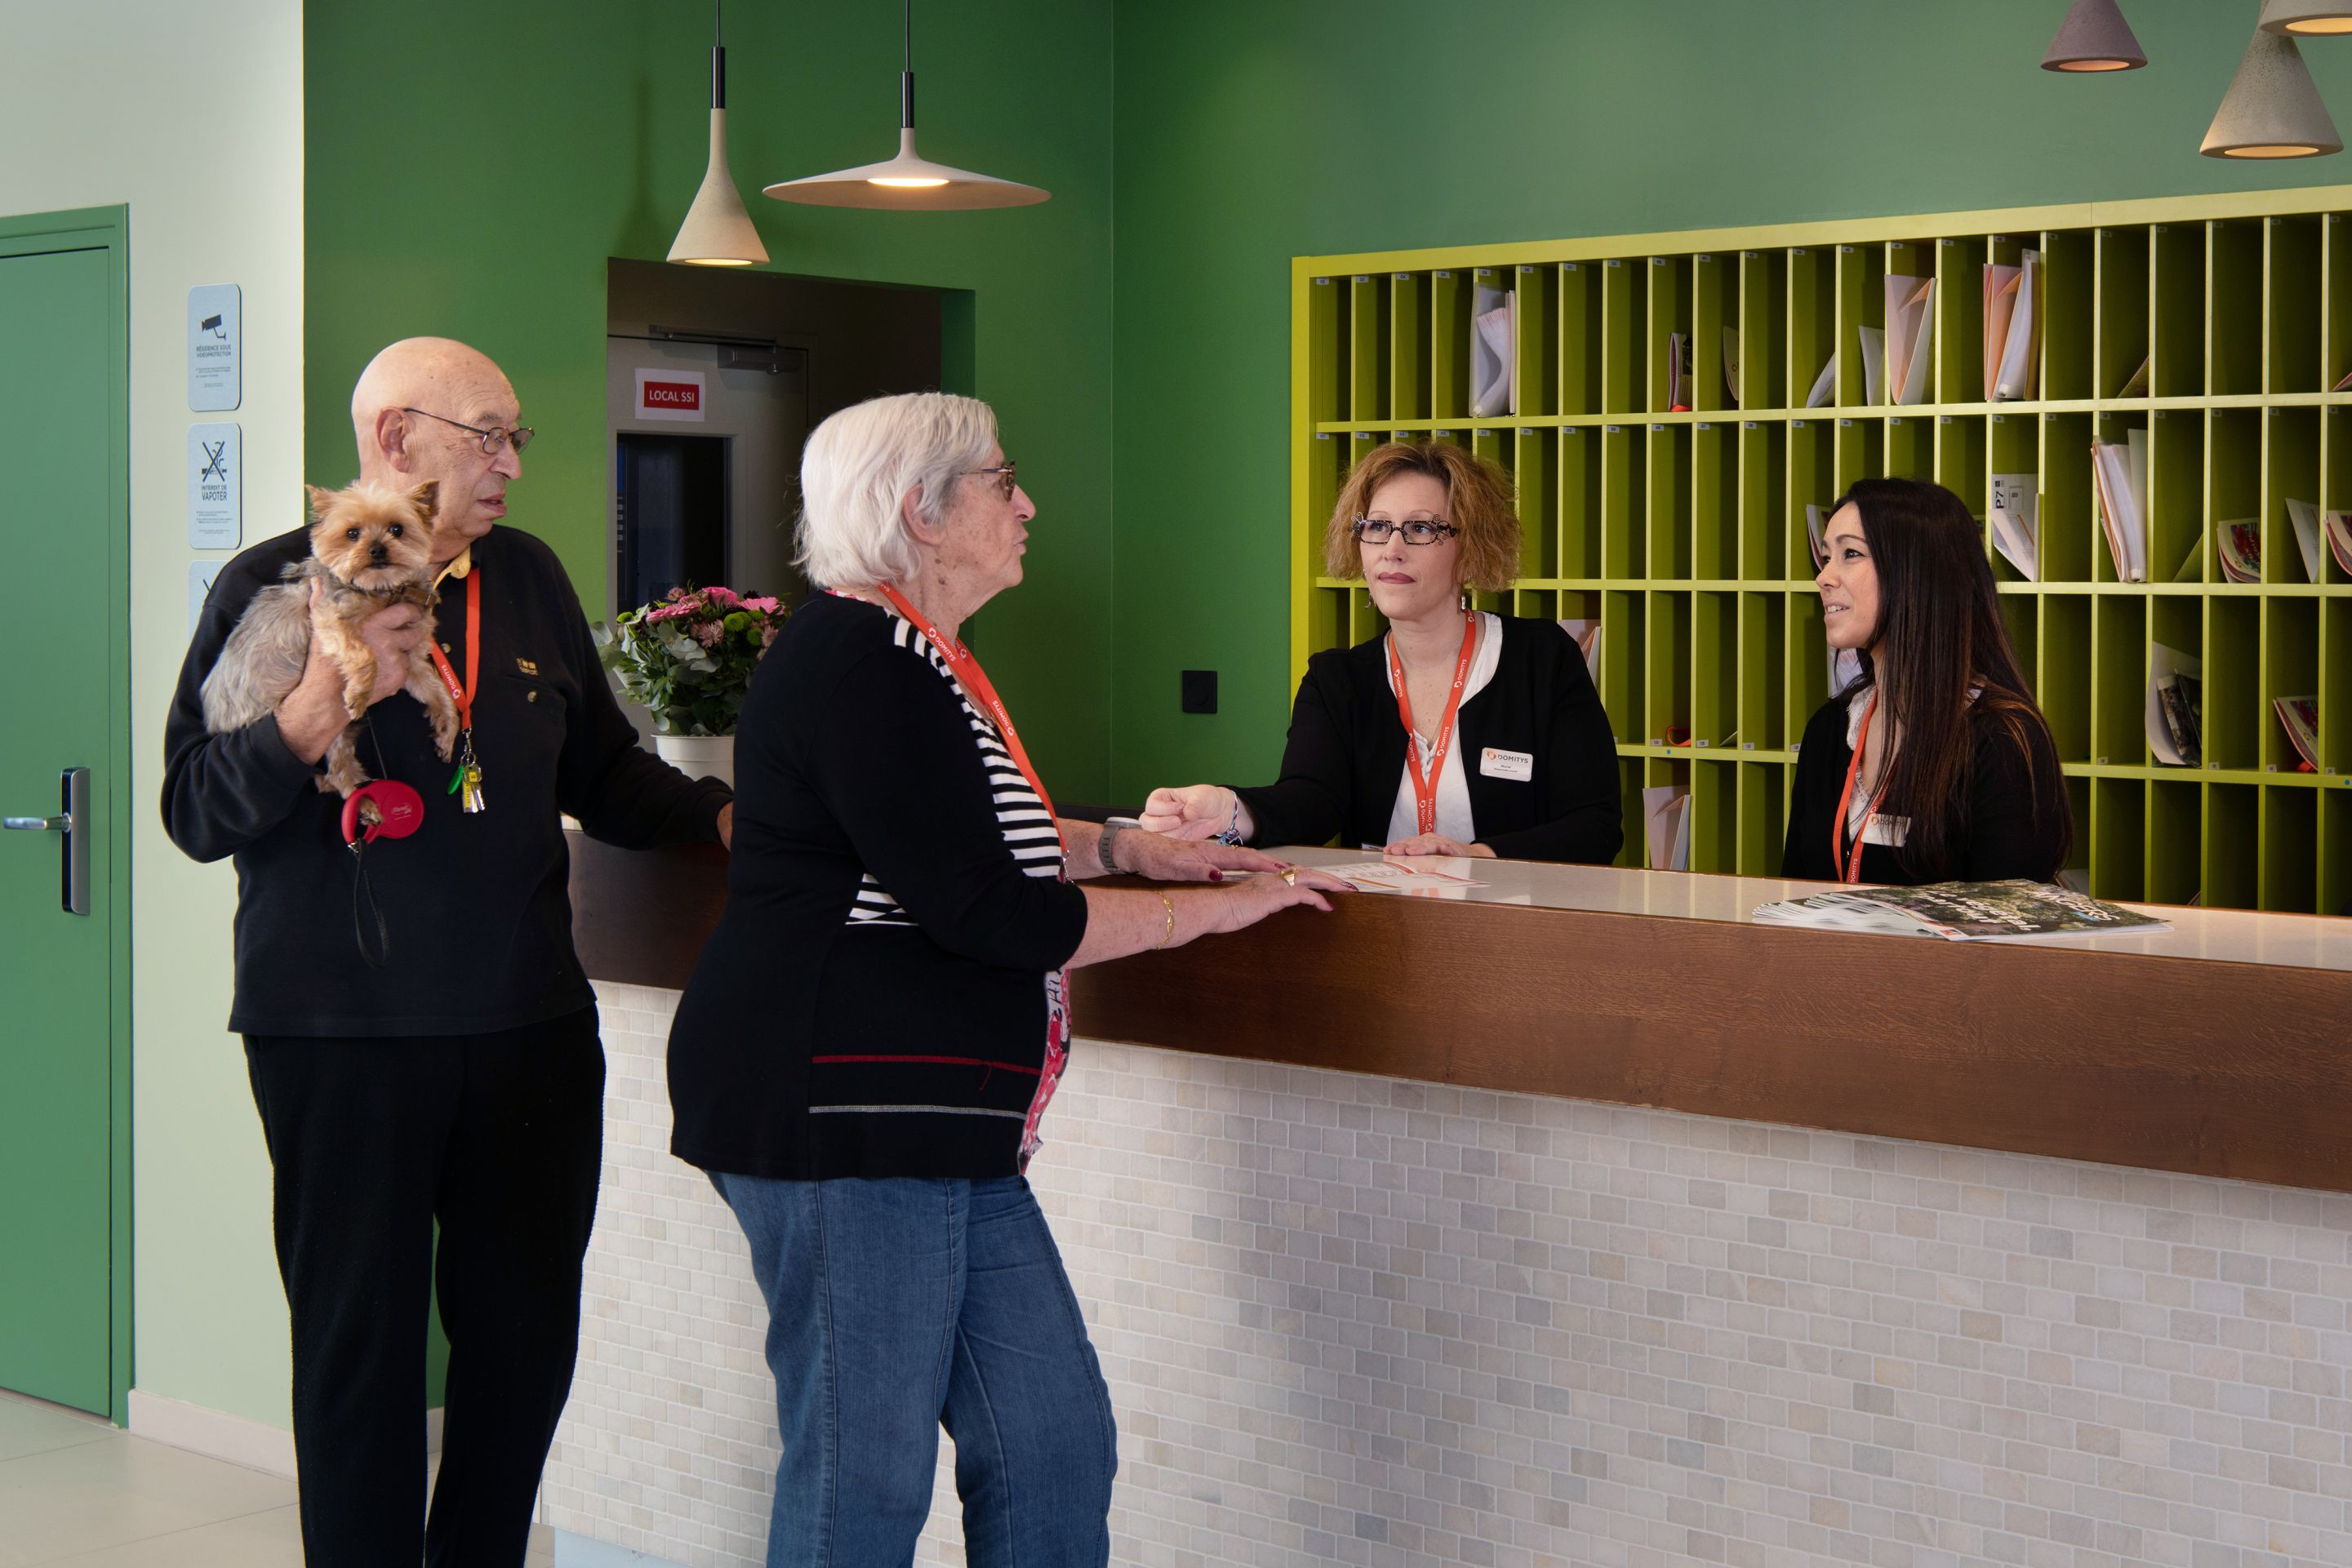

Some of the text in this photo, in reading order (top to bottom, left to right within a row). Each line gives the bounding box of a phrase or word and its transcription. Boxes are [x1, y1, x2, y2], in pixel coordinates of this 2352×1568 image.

[649, 389, 695, 402] LOCAL SSI
[202, 491, 228, 501] VAPOTER
[936, 637, 957, 662] DOMITYS
[441, 664, 456, 690] DOMITYS
[1457, 659, 1467, 681] DOMITYS
[992, 700, 1010, 726] DOMITYS
[1440, 726, 1450, 748] DOMITYS
[1497, 754, 1529, 764] DOMITYS
